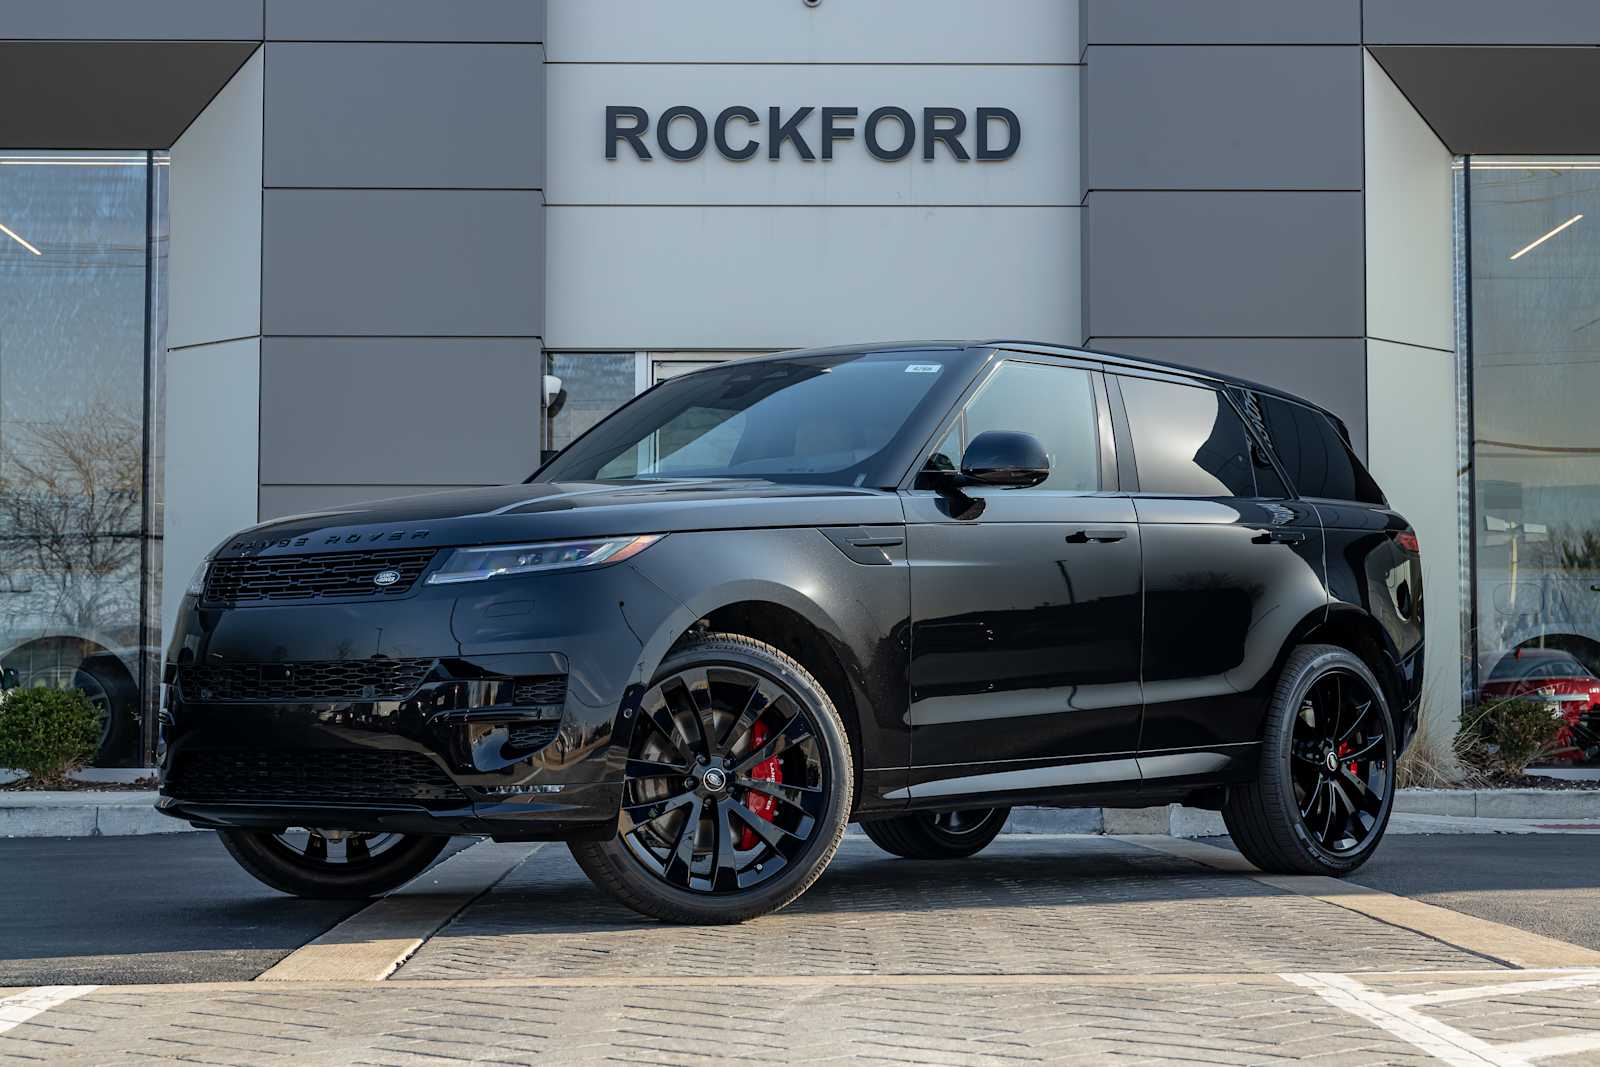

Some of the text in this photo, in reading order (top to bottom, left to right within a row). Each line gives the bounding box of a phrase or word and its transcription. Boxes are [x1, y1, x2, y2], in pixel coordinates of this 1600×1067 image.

[605, 105, 1021, 161] ROCKFORD
[231, 529, 431, 551] RANGE ROVER
